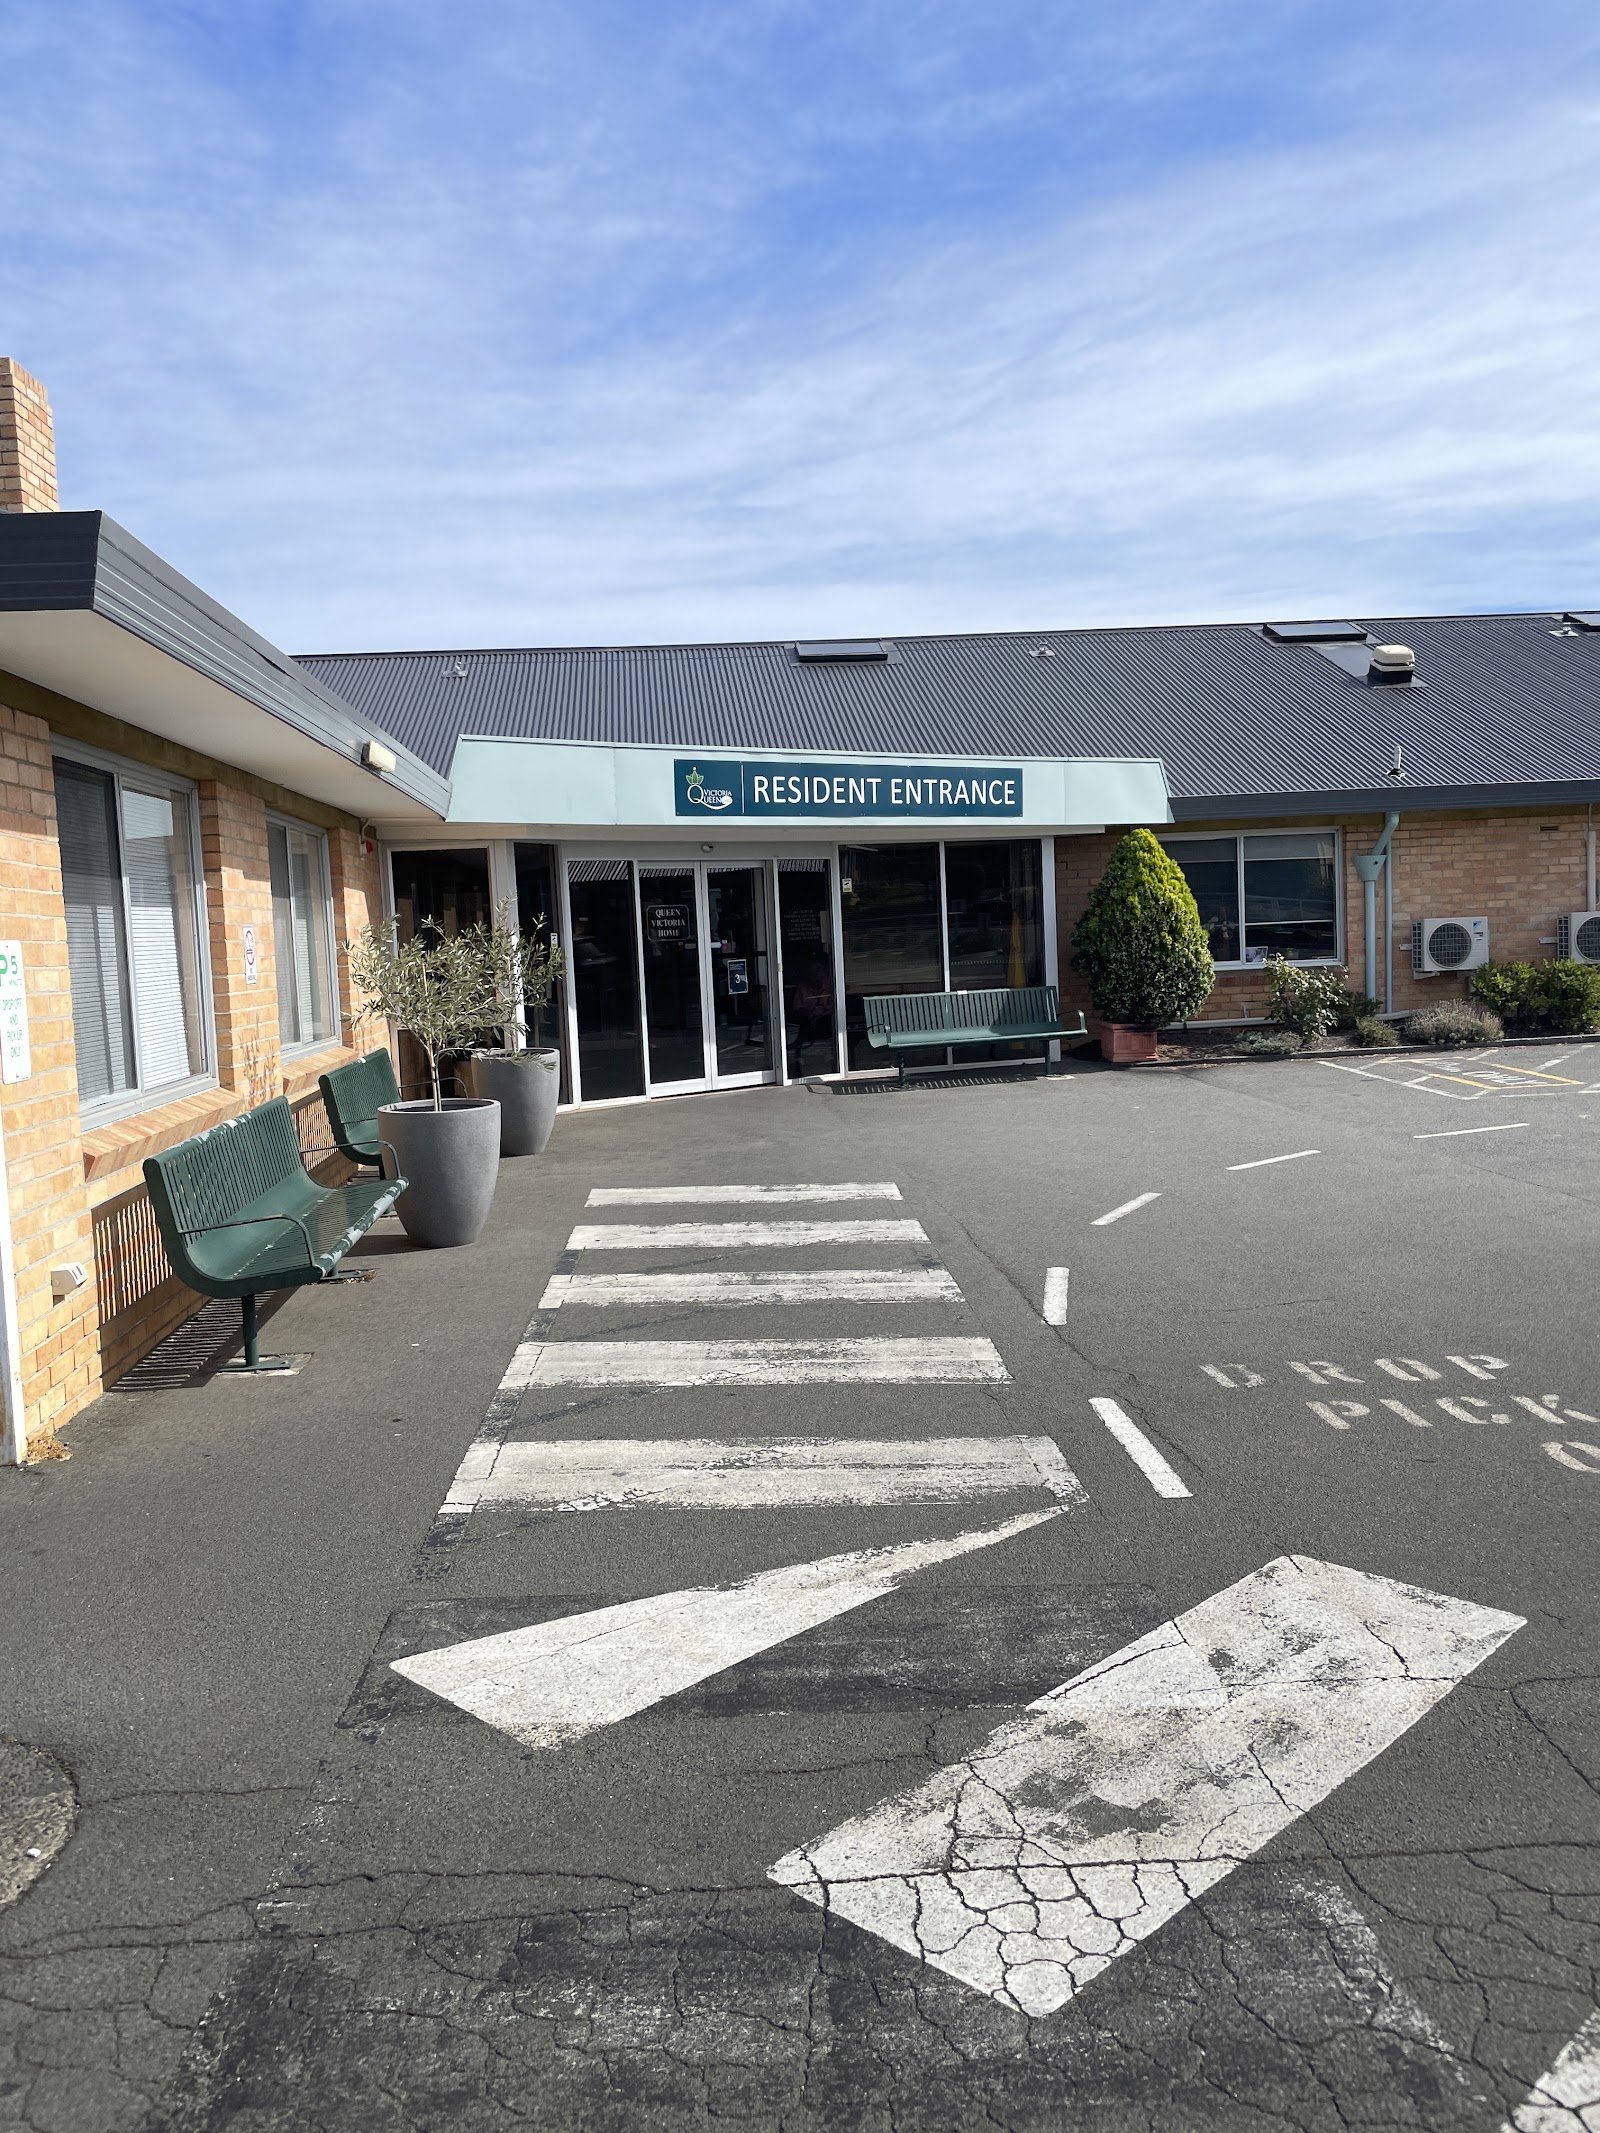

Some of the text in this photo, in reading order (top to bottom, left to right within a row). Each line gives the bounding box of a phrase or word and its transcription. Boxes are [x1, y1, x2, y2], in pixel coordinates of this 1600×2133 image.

[754, 775, 1016, 805] RESIDENT ENTRANCE
[651, 918, 686, 927] VICTORIA
[655, 908, 681, 918] QUEEN
[658, 929, 680, 937] HOME
[10, 955, 18, 974] 5
[1199, 1354, 1510, 1389] DROP
[1305, 1393, 1600, 1430] PICK
